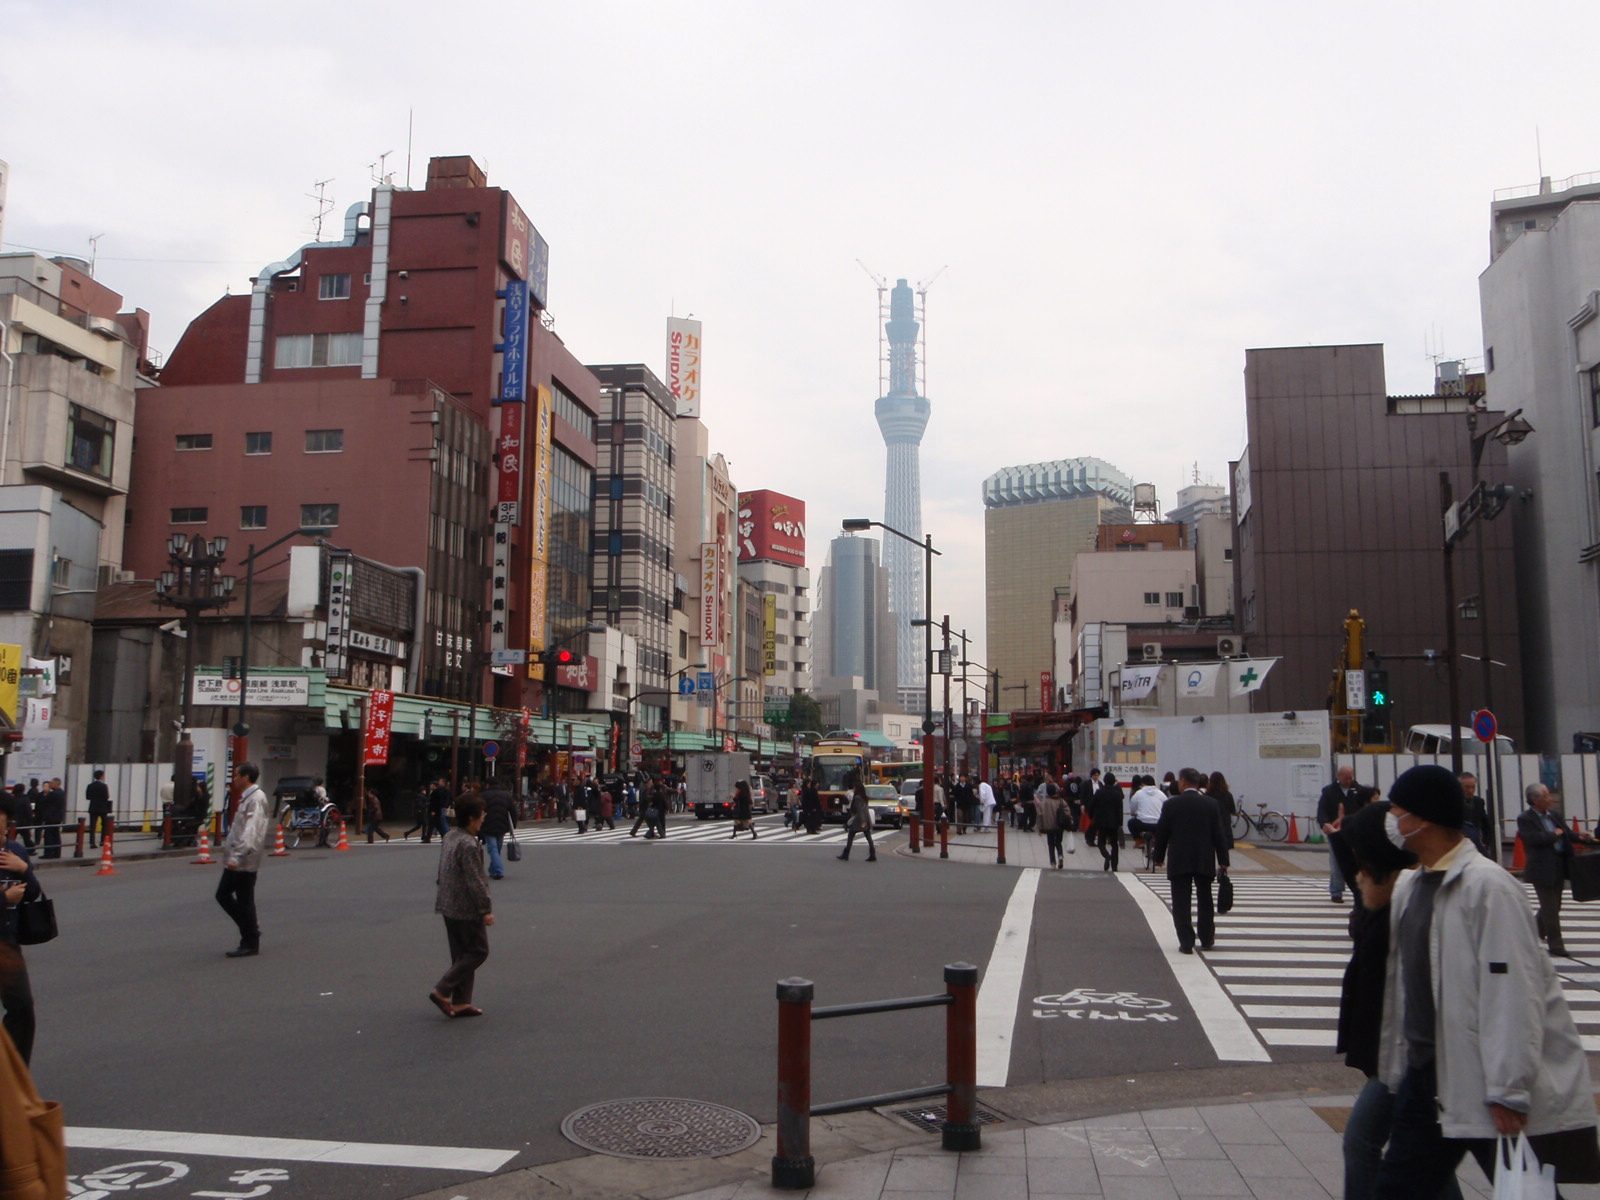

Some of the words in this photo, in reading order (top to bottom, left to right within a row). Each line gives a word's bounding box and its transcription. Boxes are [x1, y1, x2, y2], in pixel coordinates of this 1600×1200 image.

[670, 331, 683, 401] SHIDAX
[683, 332, 699, 402] カラオケ
[504, 386, 520, 399] 5F
[501, 434, 519, 473] 和民
[500, 502, 516, 512] 3F
[773, 520, 806, 539] つぼ八
[704, 547, 715, 593] カラオケ
[705, 595, 714, 641] SHIDAX
[198, 680, 222, 688] 地下鉄
[272, 680, 298, 688] 浅草駅
[566, 655, 588, 688] 和民
